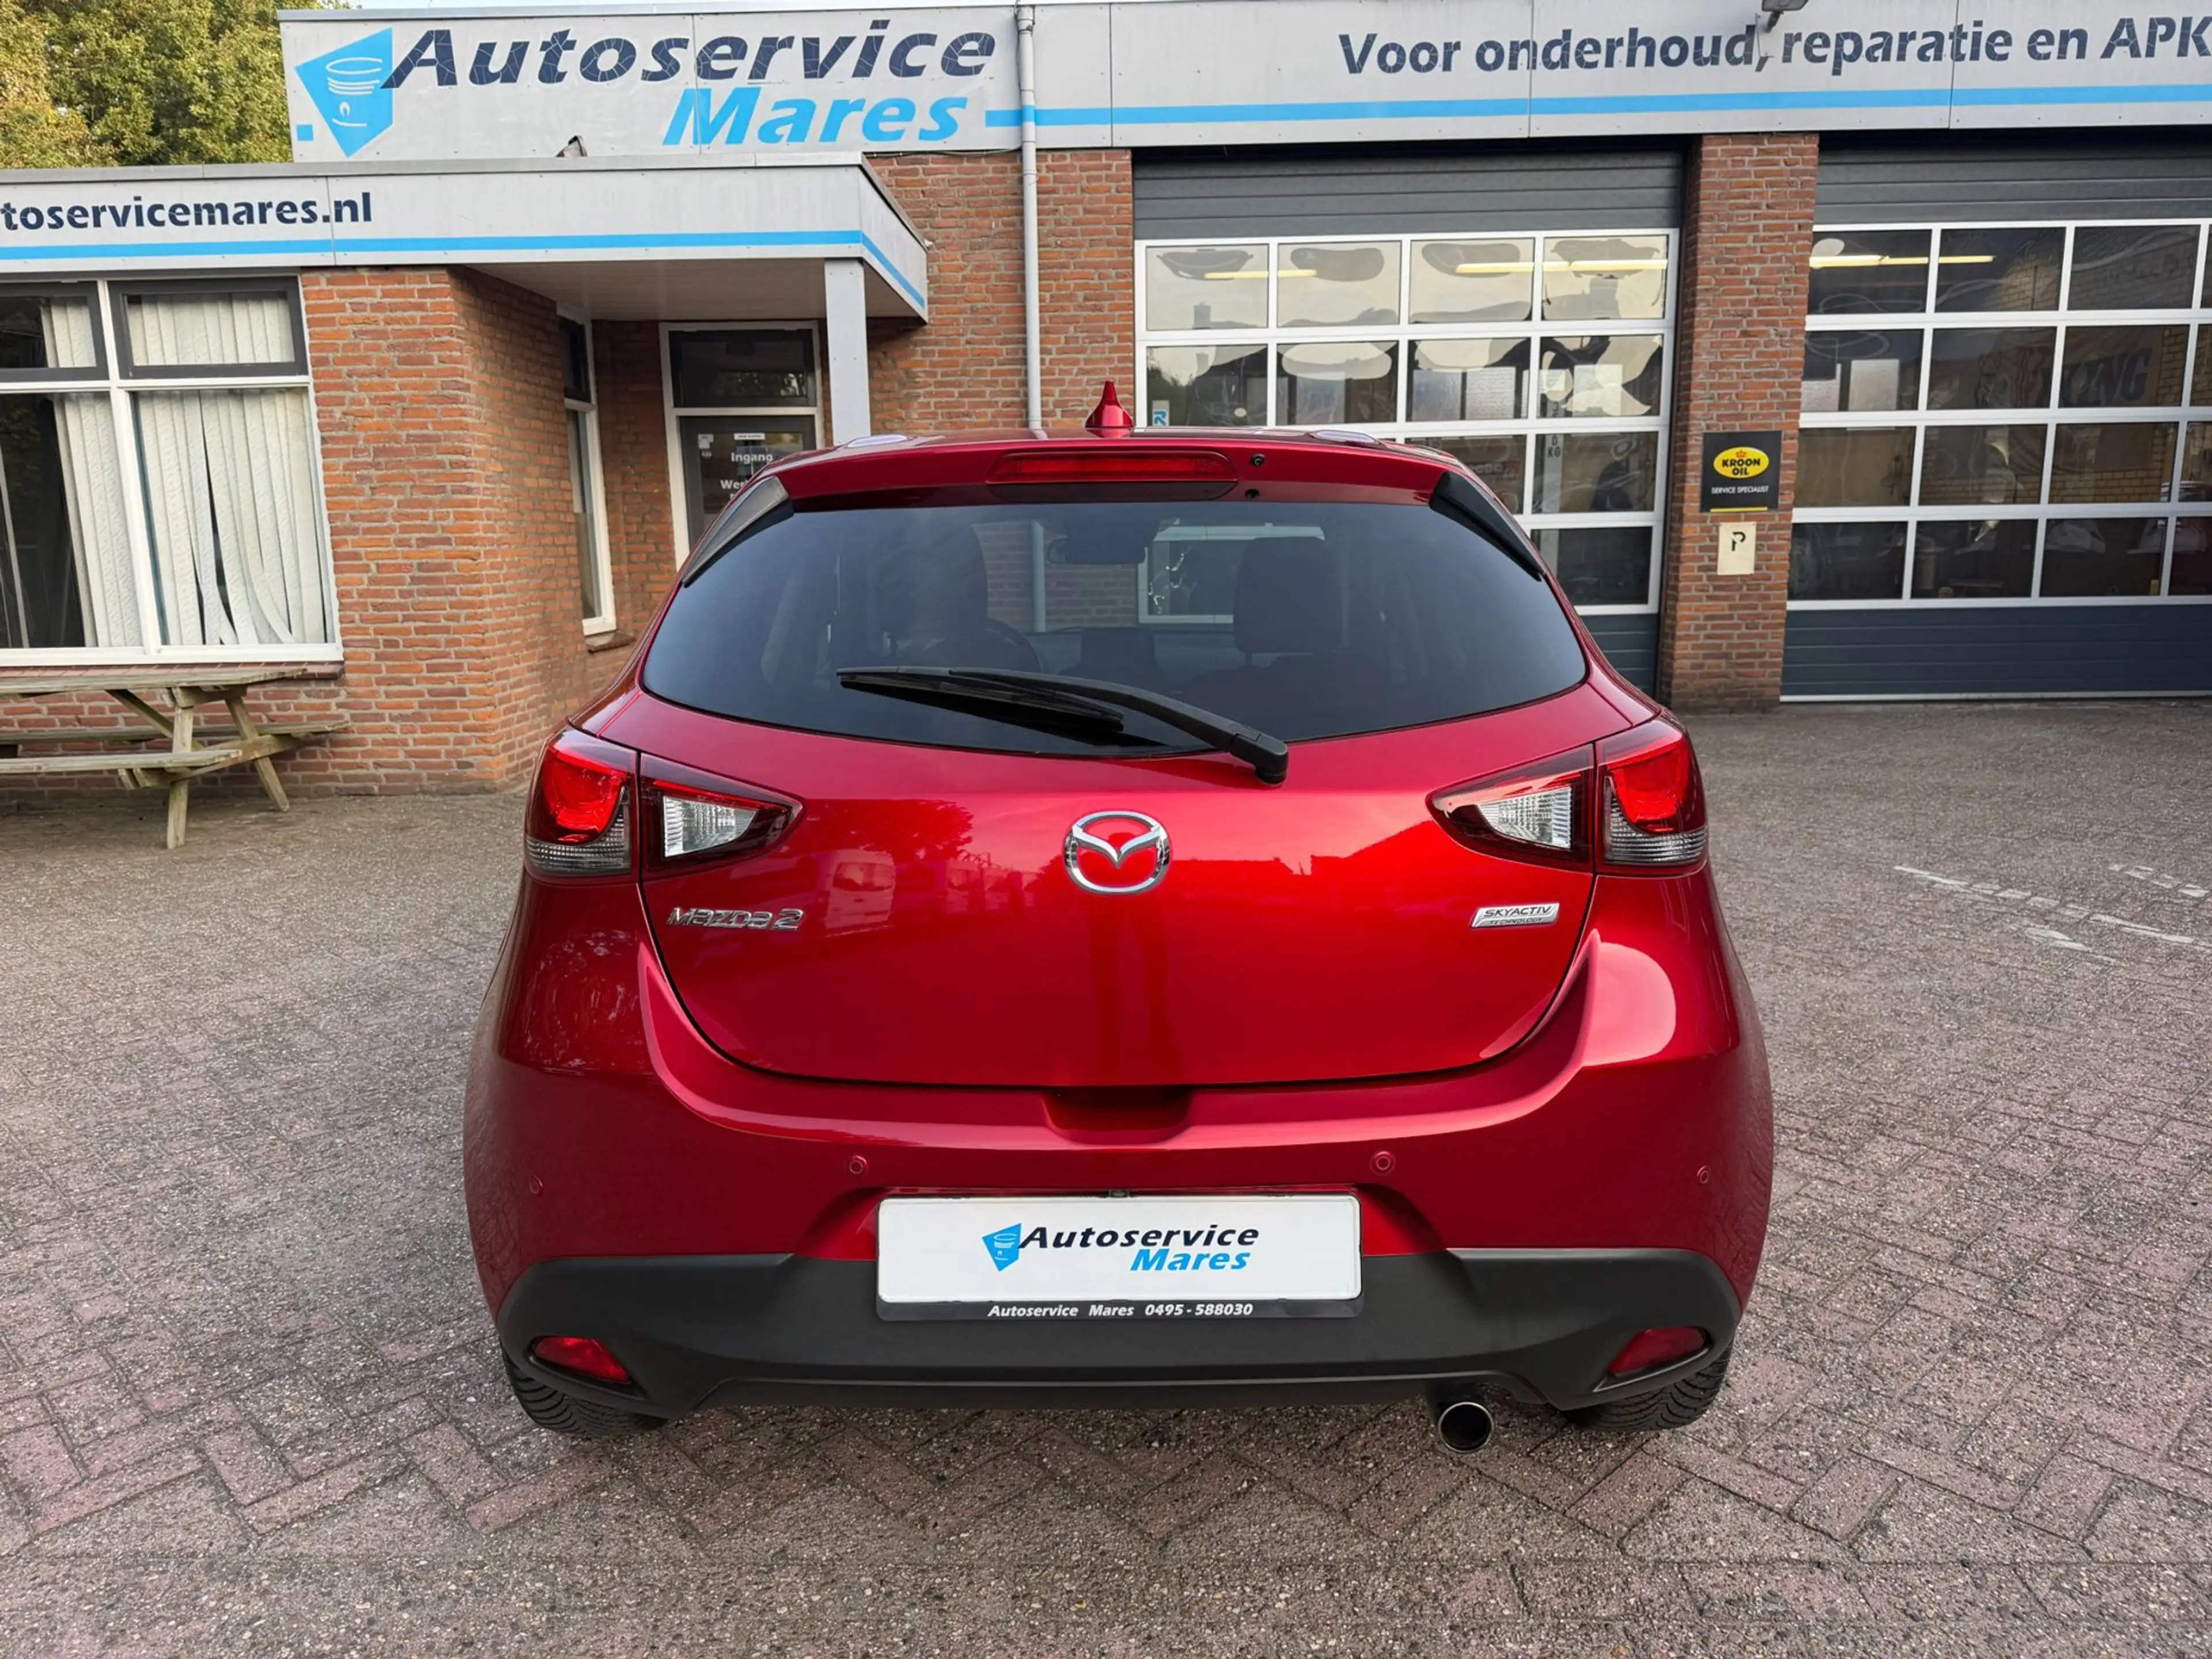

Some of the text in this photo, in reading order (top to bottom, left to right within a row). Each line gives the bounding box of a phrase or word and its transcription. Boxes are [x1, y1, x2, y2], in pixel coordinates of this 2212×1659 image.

[381, 20, 995, 88] Autoservice
[1339, 16, 2212, 76] Voor onderhoud, reparatie en APK
[663, 86, 968, 145] Mares
[1722, 458, 1761, 468] KROON
[1732, 467, 1749, 476] OIL
[1711, 485, 1770, 495] SERVICE SPECIALIST
[1732, 532, 1746, 551] P
[1484, 906, 1552, 917] SKYACTIV
[1490, 917, 1543, 925] TECHNOLOGY
[1018, 1224, 1259, 1249] Autoservice
[1130, 1248, 1251, 1271] Mares
[987, 1304, 1079, 1317] Autoservice
[1088, 1304, 1134, 1317] Mares
